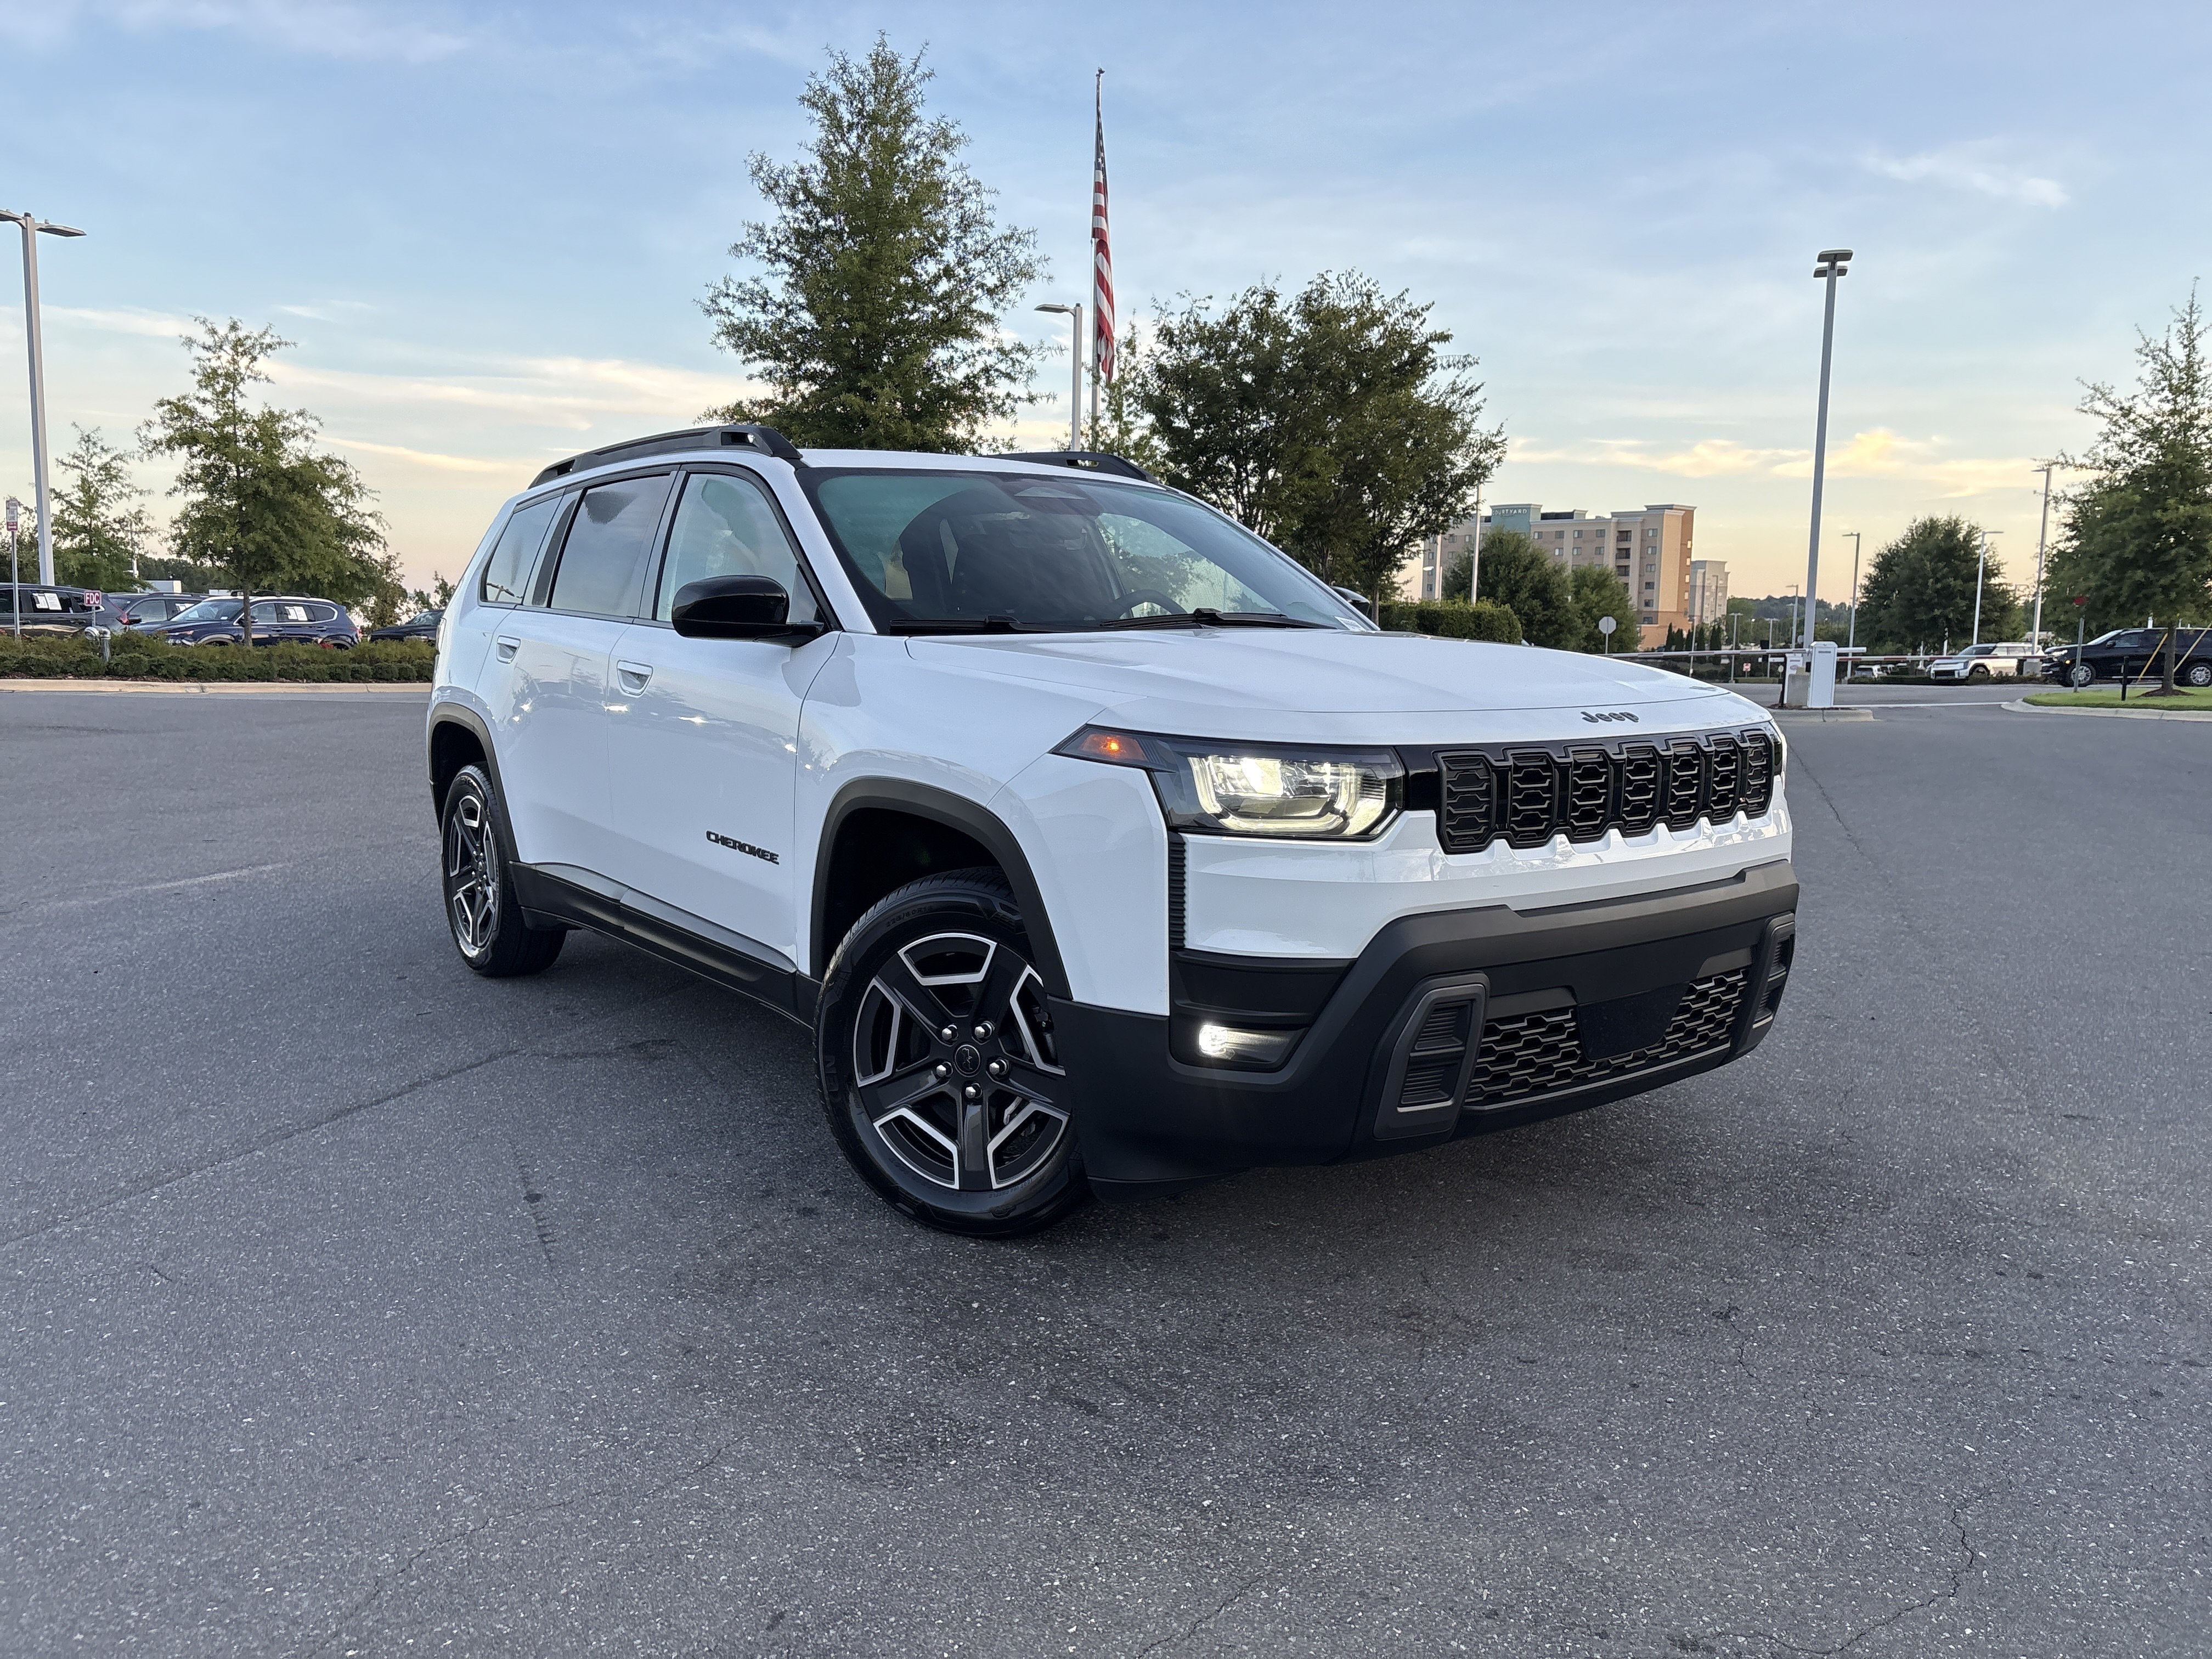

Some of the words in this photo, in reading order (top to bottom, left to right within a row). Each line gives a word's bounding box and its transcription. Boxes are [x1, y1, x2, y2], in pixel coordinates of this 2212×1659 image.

[86, 592, 99, 603] FDC
[1580, 711, 1639, 723] Jeep
[706, 830, 780, 865] CHEROKEE
